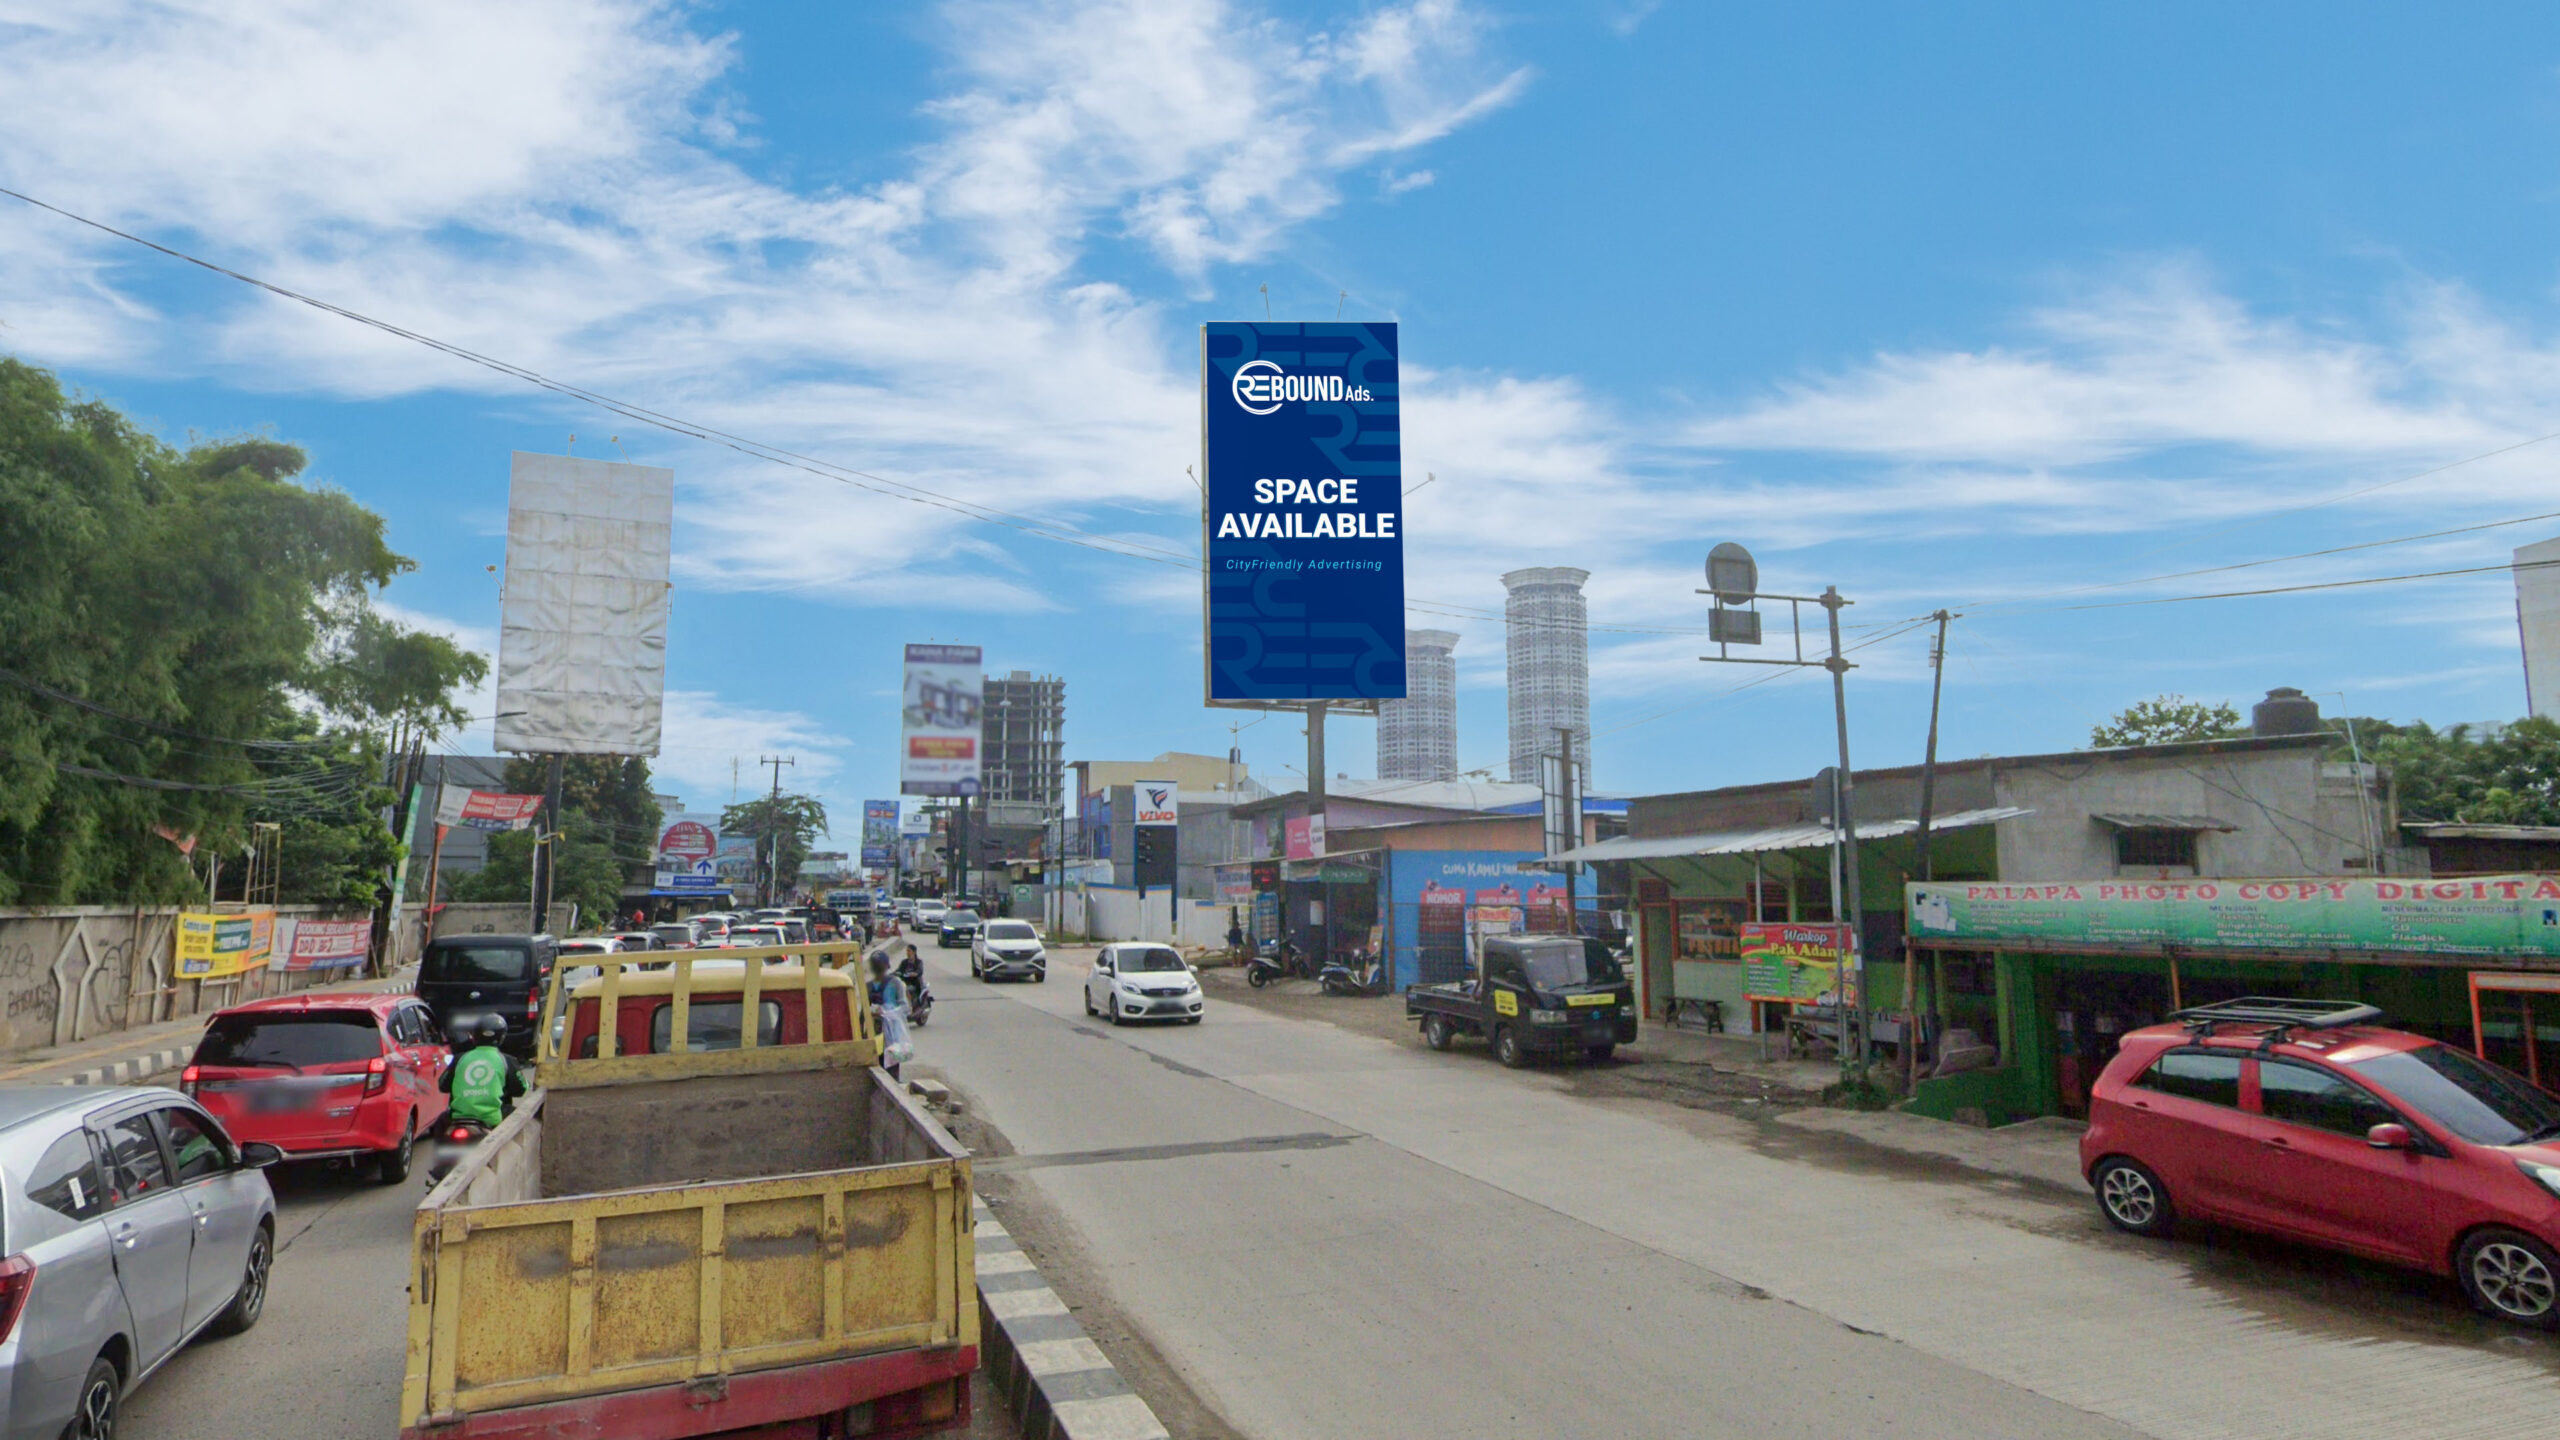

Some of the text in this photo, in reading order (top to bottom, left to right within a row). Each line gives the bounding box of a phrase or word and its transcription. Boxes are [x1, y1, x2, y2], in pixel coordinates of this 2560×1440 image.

[1234, 375, 1374, 402] REBOUND Ads.
[1254, 478, 1358, 504] SPACE
[1217, 512, 1396, 538] AVAILABLE
[1226, 559, 1382, 571] CityFriendly Advertising
[1467, 863, 1500, 877] KAMU
[1967, 884, 2082, 900] PALAPA
[2100, 884, 2218, 900] PHOTO
[2238, 882, 2348, 900] COPY
[1783, 929, 1828, 944] Warkop
[1770, 942, 1797, 956] Pak
